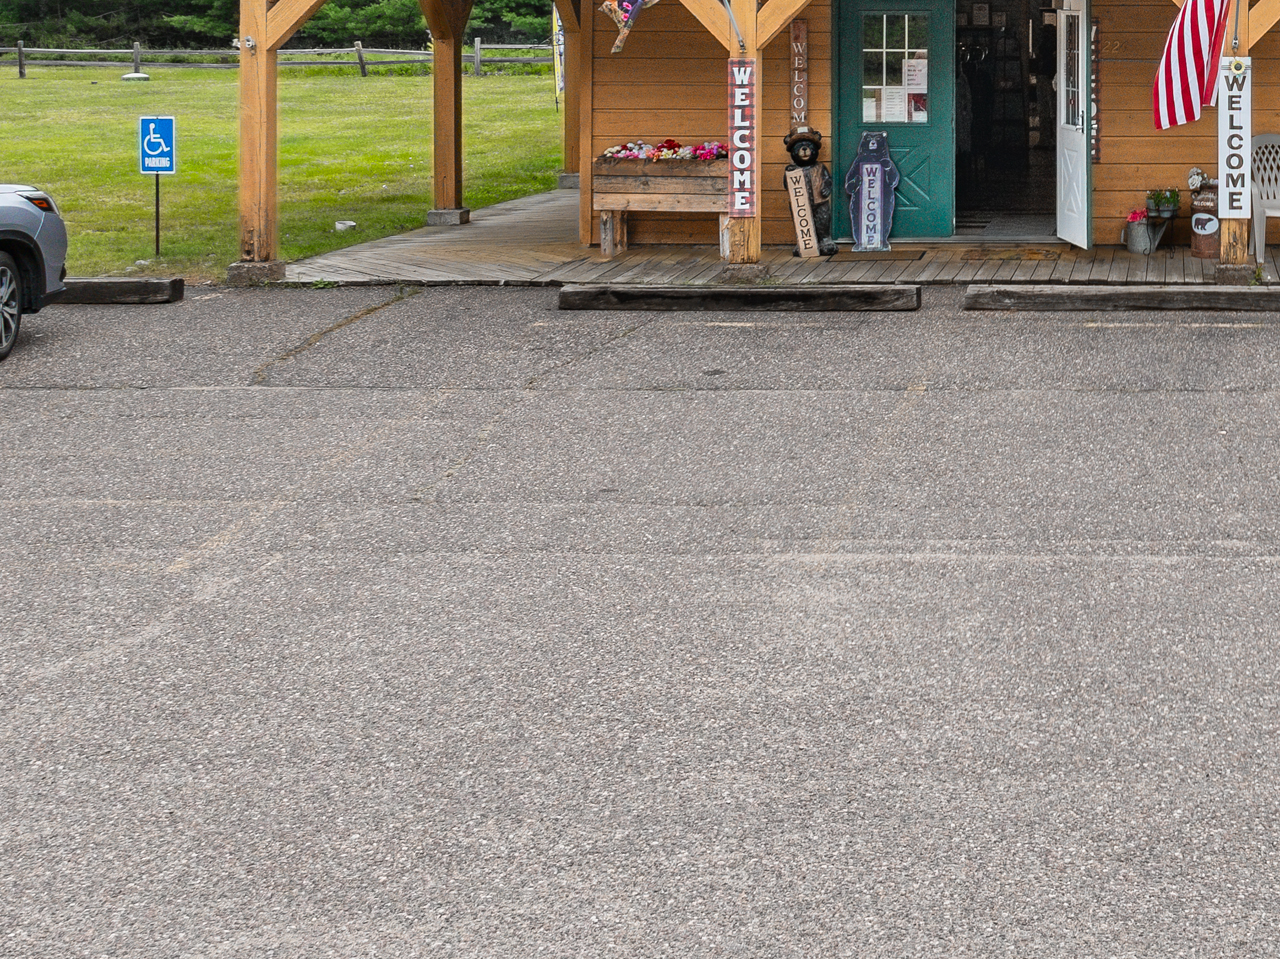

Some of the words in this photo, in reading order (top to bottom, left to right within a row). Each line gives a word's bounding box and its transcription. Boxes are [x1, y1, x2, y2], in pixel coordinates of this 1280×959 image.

[791, 42, 807, 127] WELCOM
[144, 157, 170, 168] PARKING
[732, 67, 752, 210] WELCOME
[1224, 75, 1247, 210] WELCOME
[790, 176, 814, 250] WELCOME
[865, 167, 878, 246] WELCOME
